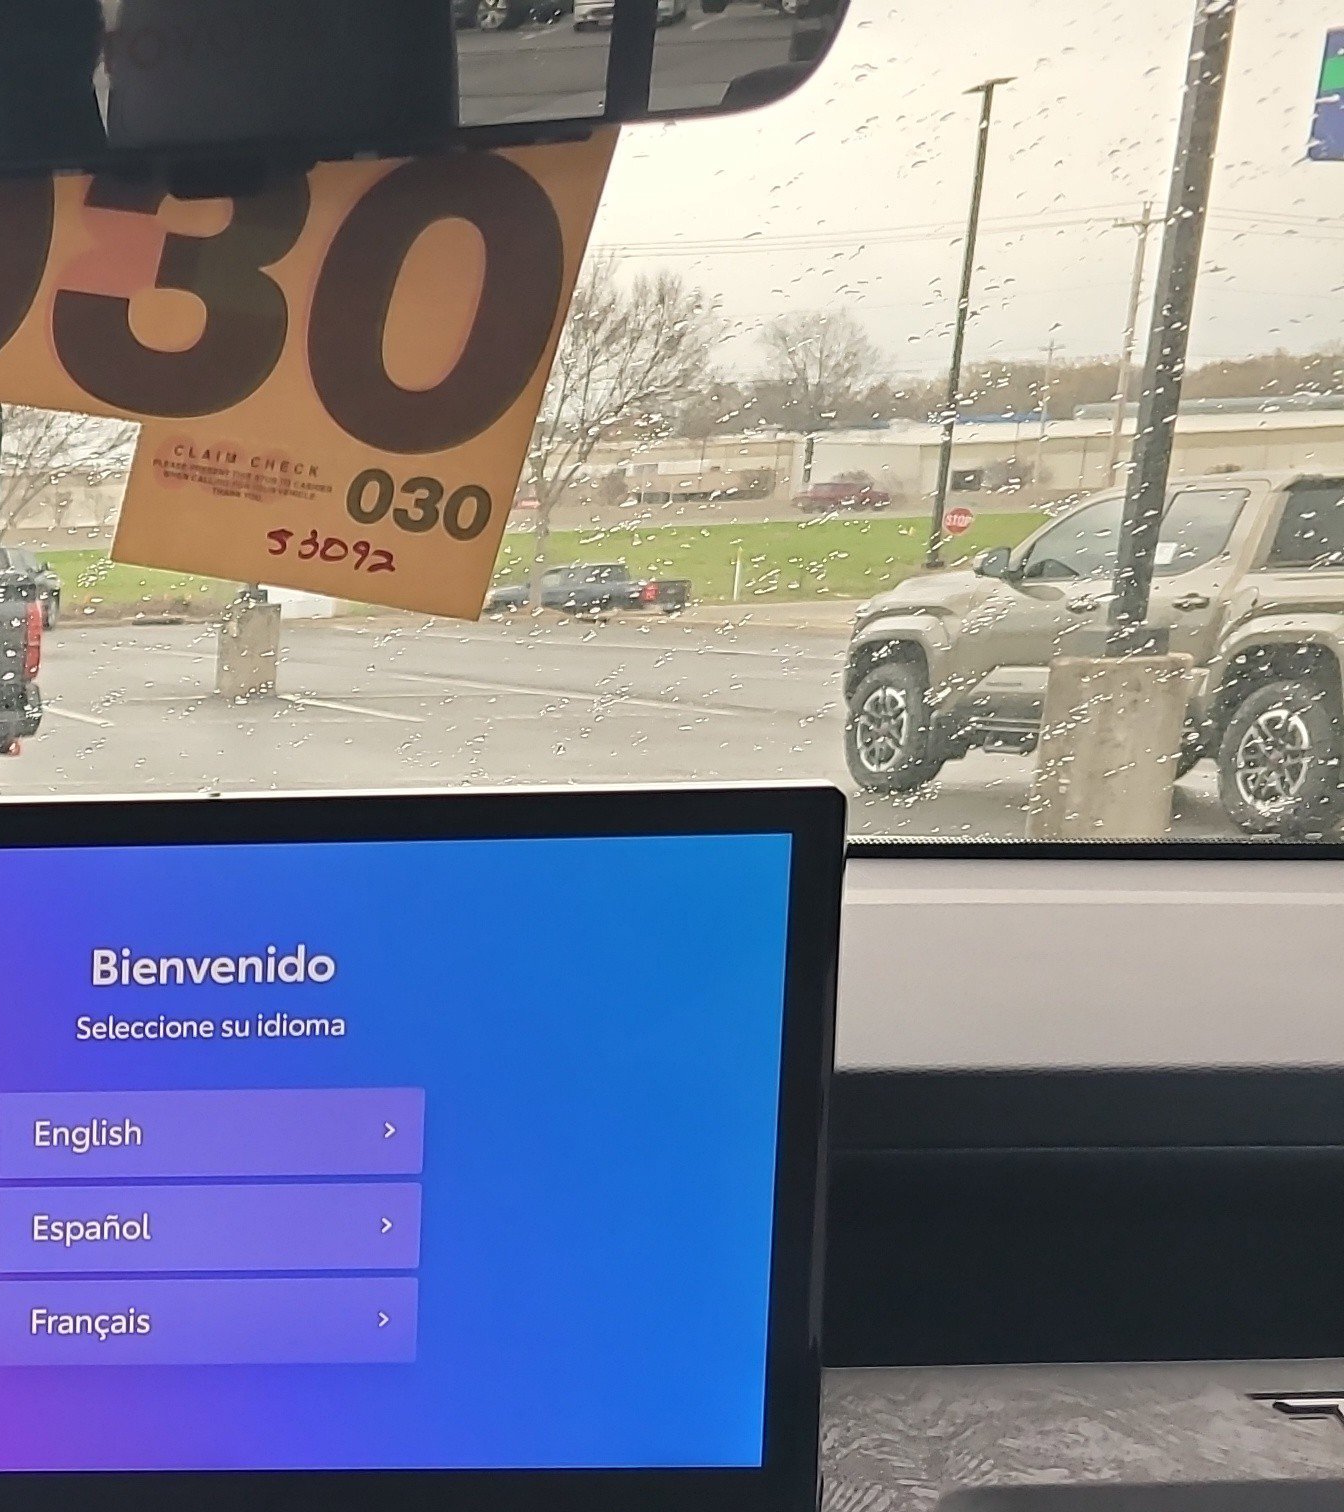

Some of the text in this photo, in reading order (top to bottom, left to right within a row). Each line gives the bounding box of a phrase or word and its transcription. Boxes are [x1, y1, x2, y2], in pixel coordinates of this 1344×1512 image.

[173, 444, 237, 465] CLAIM
[250, 455, 320, 478] CHECK
[346, 468, 493, 542] 030
[944, 514, 971, 527] STOP
[91, 944, 336, 986] Bienvenido
[76, 1013, 346, 1040] Seleccione su idioma
[33, 1118, 143, 1153] English
[32, 1213, 152, 1247] Español
[30, 1307, 152, 1340] Français
